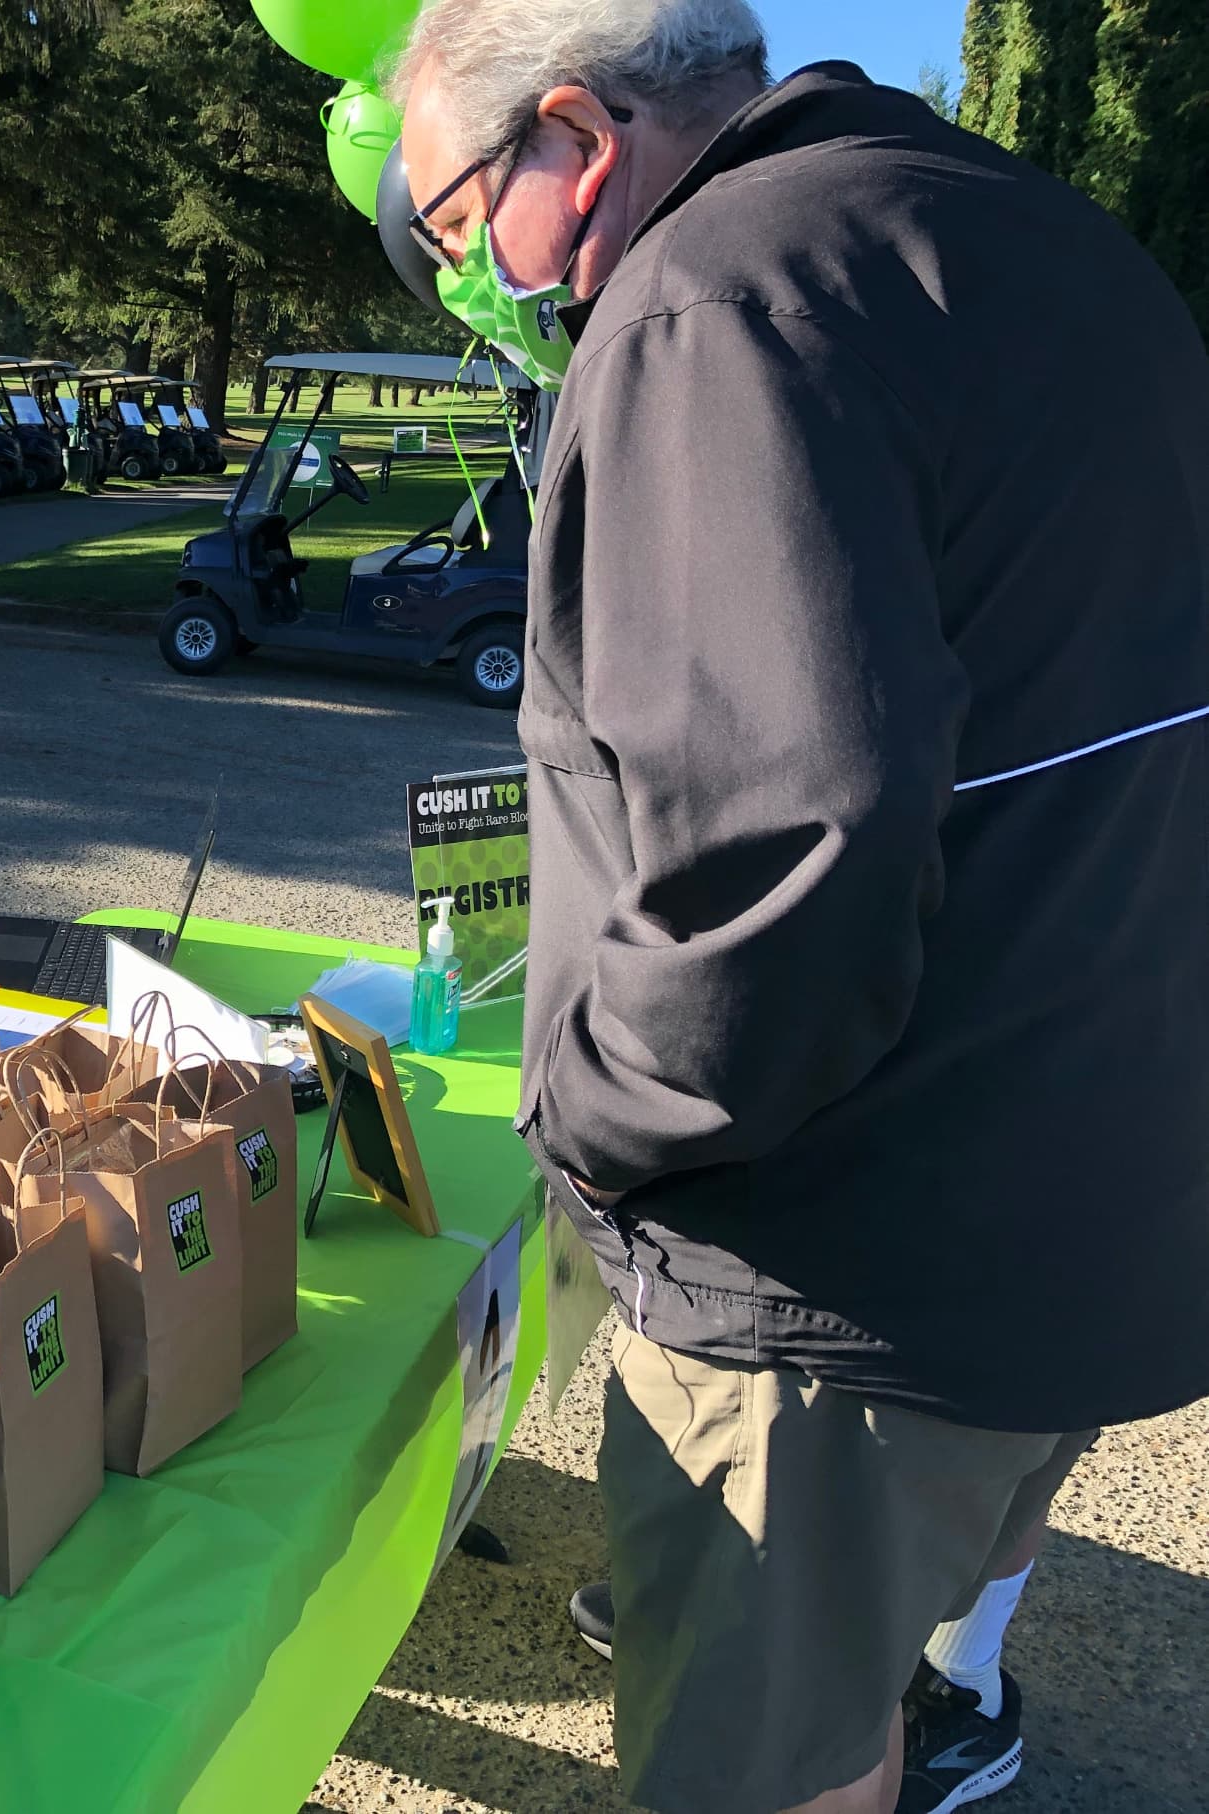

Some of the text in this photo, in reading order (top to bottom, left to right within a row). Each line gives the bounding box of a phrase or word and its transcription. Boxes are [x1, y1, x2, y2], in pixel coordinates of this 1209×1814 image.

[383, 598, 391, 607] 3
[416, 782, 520, 816] CUSH IT TO
[418, 822, 445, 835] Unite
[446, 821, 457, 831] to
[457, 816, 484, 831] Fight
[485, 815, 509, 826] Rare
[239, 1131, 268, 1157] CUSH
[245, 1145, 273, 1171] IT TO
[169, 1193, 200, 1221] CUSH
[171, 1210, 201, 1237] IT TO
[182, 1223, 204, 1247] THE
[177, 1238, 207, 1268] LIMIT
[24, 1298, 55, 1337] CUSH
[26, 1316, 56, 1354] IT TO
